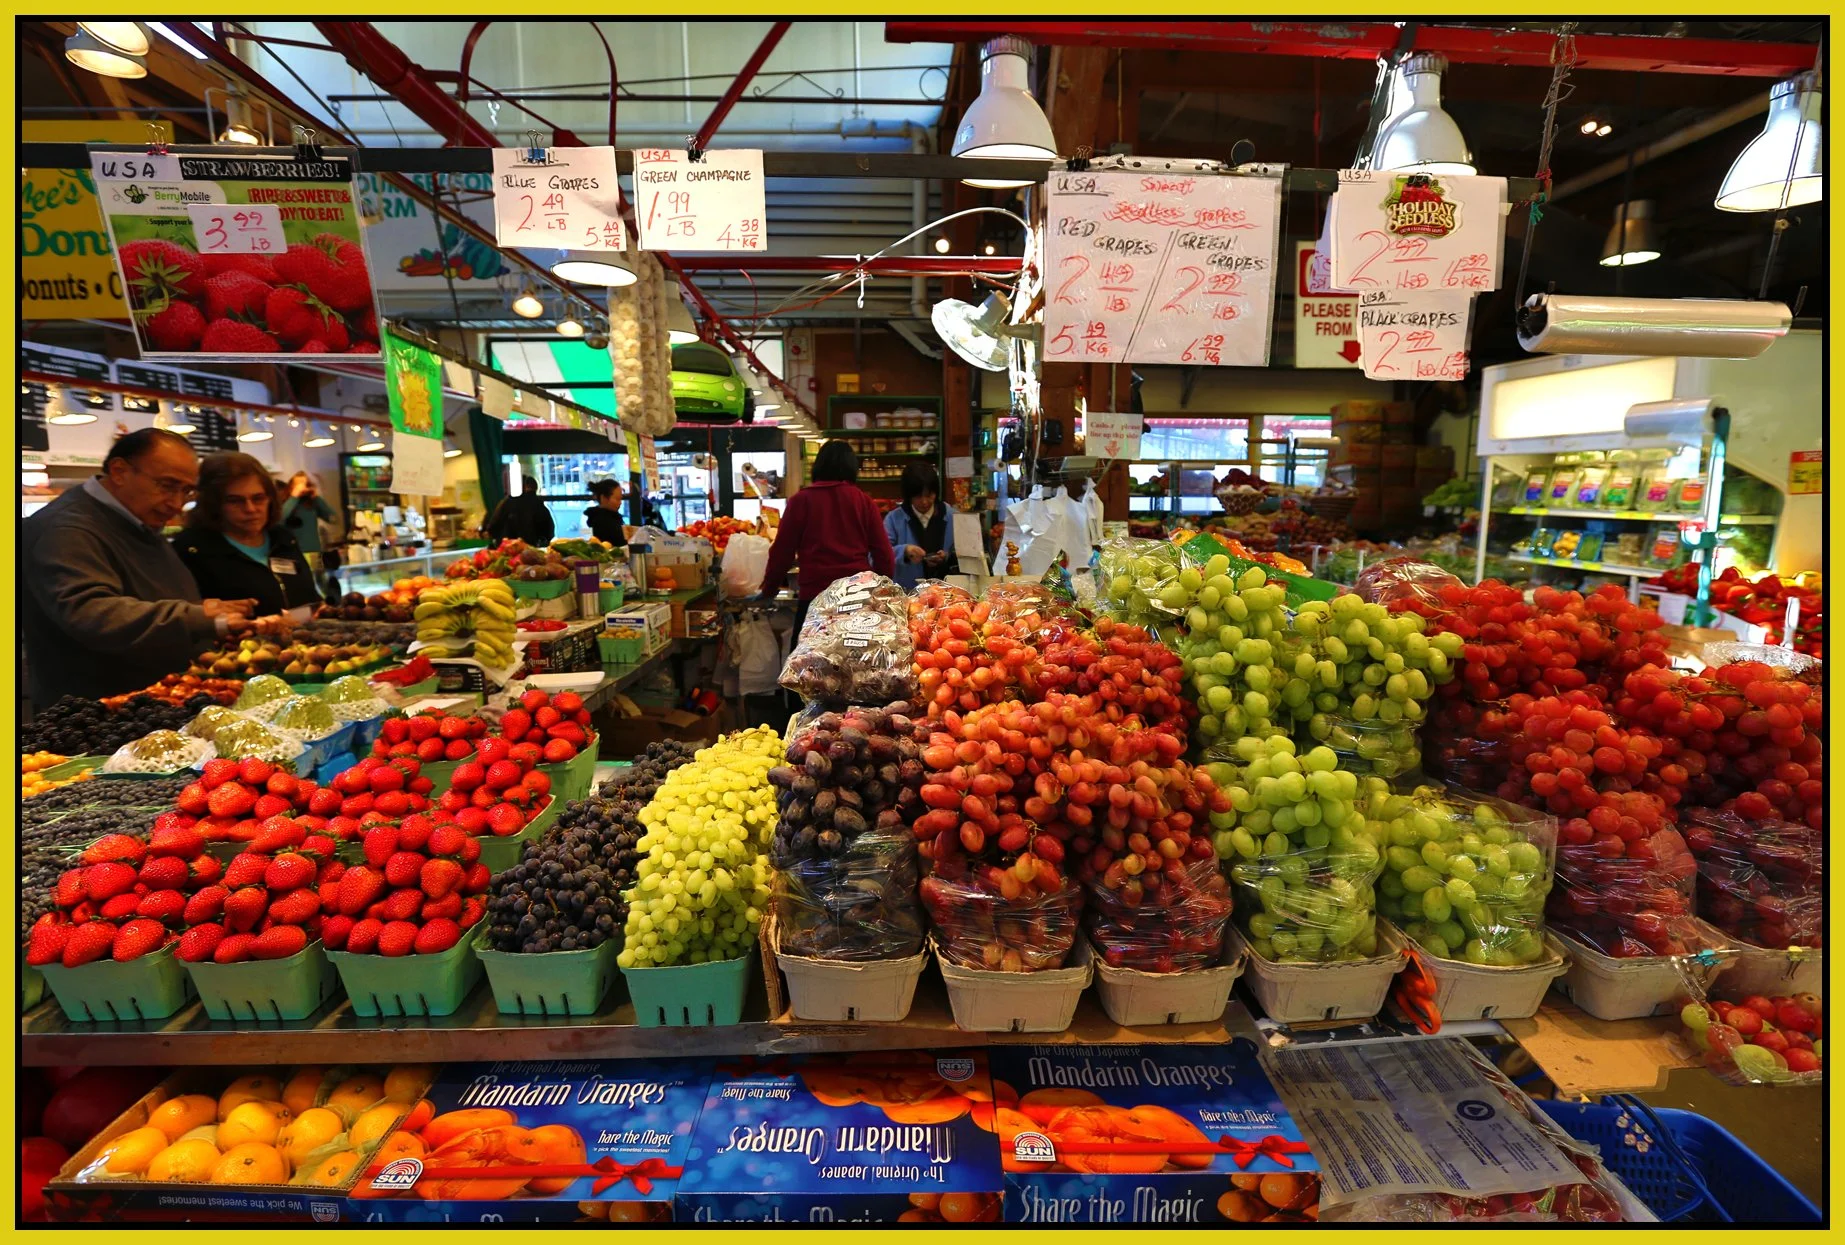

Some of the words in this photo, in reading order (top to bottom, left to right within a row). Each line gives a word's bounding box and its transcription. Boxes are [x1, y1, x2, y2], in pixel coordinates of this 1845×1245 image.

[642, 150, 671, 160] USA
[102, 161, 155, 178] USA
[182, 160, 341, 178] STRAWBERRIES!
[1344, 170, 1372, 180] USA
[640, 170, 678, 183] GREEN
[687, 170, 752, 182] CHAMPAGNE
[1057, 177, 1097, 192] USA
[155, 191, 210, 203] BerryMobile
[248, 187, 282, 203] RIPE
[295, 188, 340, 203] SWEET
[298, 207, 315, 221] TO
[1387, 201, 1455, 216] HOLIDAY
[548, 219, 567, 231] LB
[666, 221, 696, 236] LB
[1057, 217, 1098, 237] RED
[1388, 212, 1455, 232] SEEDLESS
[251, 237, 271, 250] LB
[605, 239, 620, 250] KG
[743, 237, 758, 248] KG
[1094, 235, 1158, 255] GRAPES
[1206, 253, 1269, 272] GRAPES
[1303, 303, 1353, 318] PLEASE
[1361, 310, 1398, 327] BLACK
[1315, 322, 1353, 336] FROM
[1085, 341, 1111, 358] KG
[1053, 1046, 1093, 1058] Original
[1097, 1046, 1140, 1058] Japanese
[511, 1061, 553, 1075] Original
[554, 1061, 600, 1075] Japanese
[1028, 1057, 1140, 1087] Mandarin
[1141, 1058, 1233, 1090] Oranges
[458, 1075, 572, 1106] Mandarin
[577, 1074, 667, 1109] Oranges
[622, 1129, 640, 1144] the
[640, 1129, 674, 1147] Magic
[726, 1121, 827, 1164] Oranges
[836, 1126, 953, 1164] Mandarin
[1015, 1147, 1051, 1156] SUN
[376, 1174, 416, 1183] SUN
[872, 1165, 920, 1182] Original
[158, 1195, 206, 1206] memories!
[208, 1197, 248, 1207] sweetest
[250, 1199, 265, 1208] the
[267, 1199, 285, 1209] pick
[288, 1200, 303, 1210] We
[1019, 1184, 1081, 1222] Share
[1088, 1186, 1125, 1222] the
[1133, 1186, 1204, 1222] Magic
[313, 1206, 338, 1214] SUN
